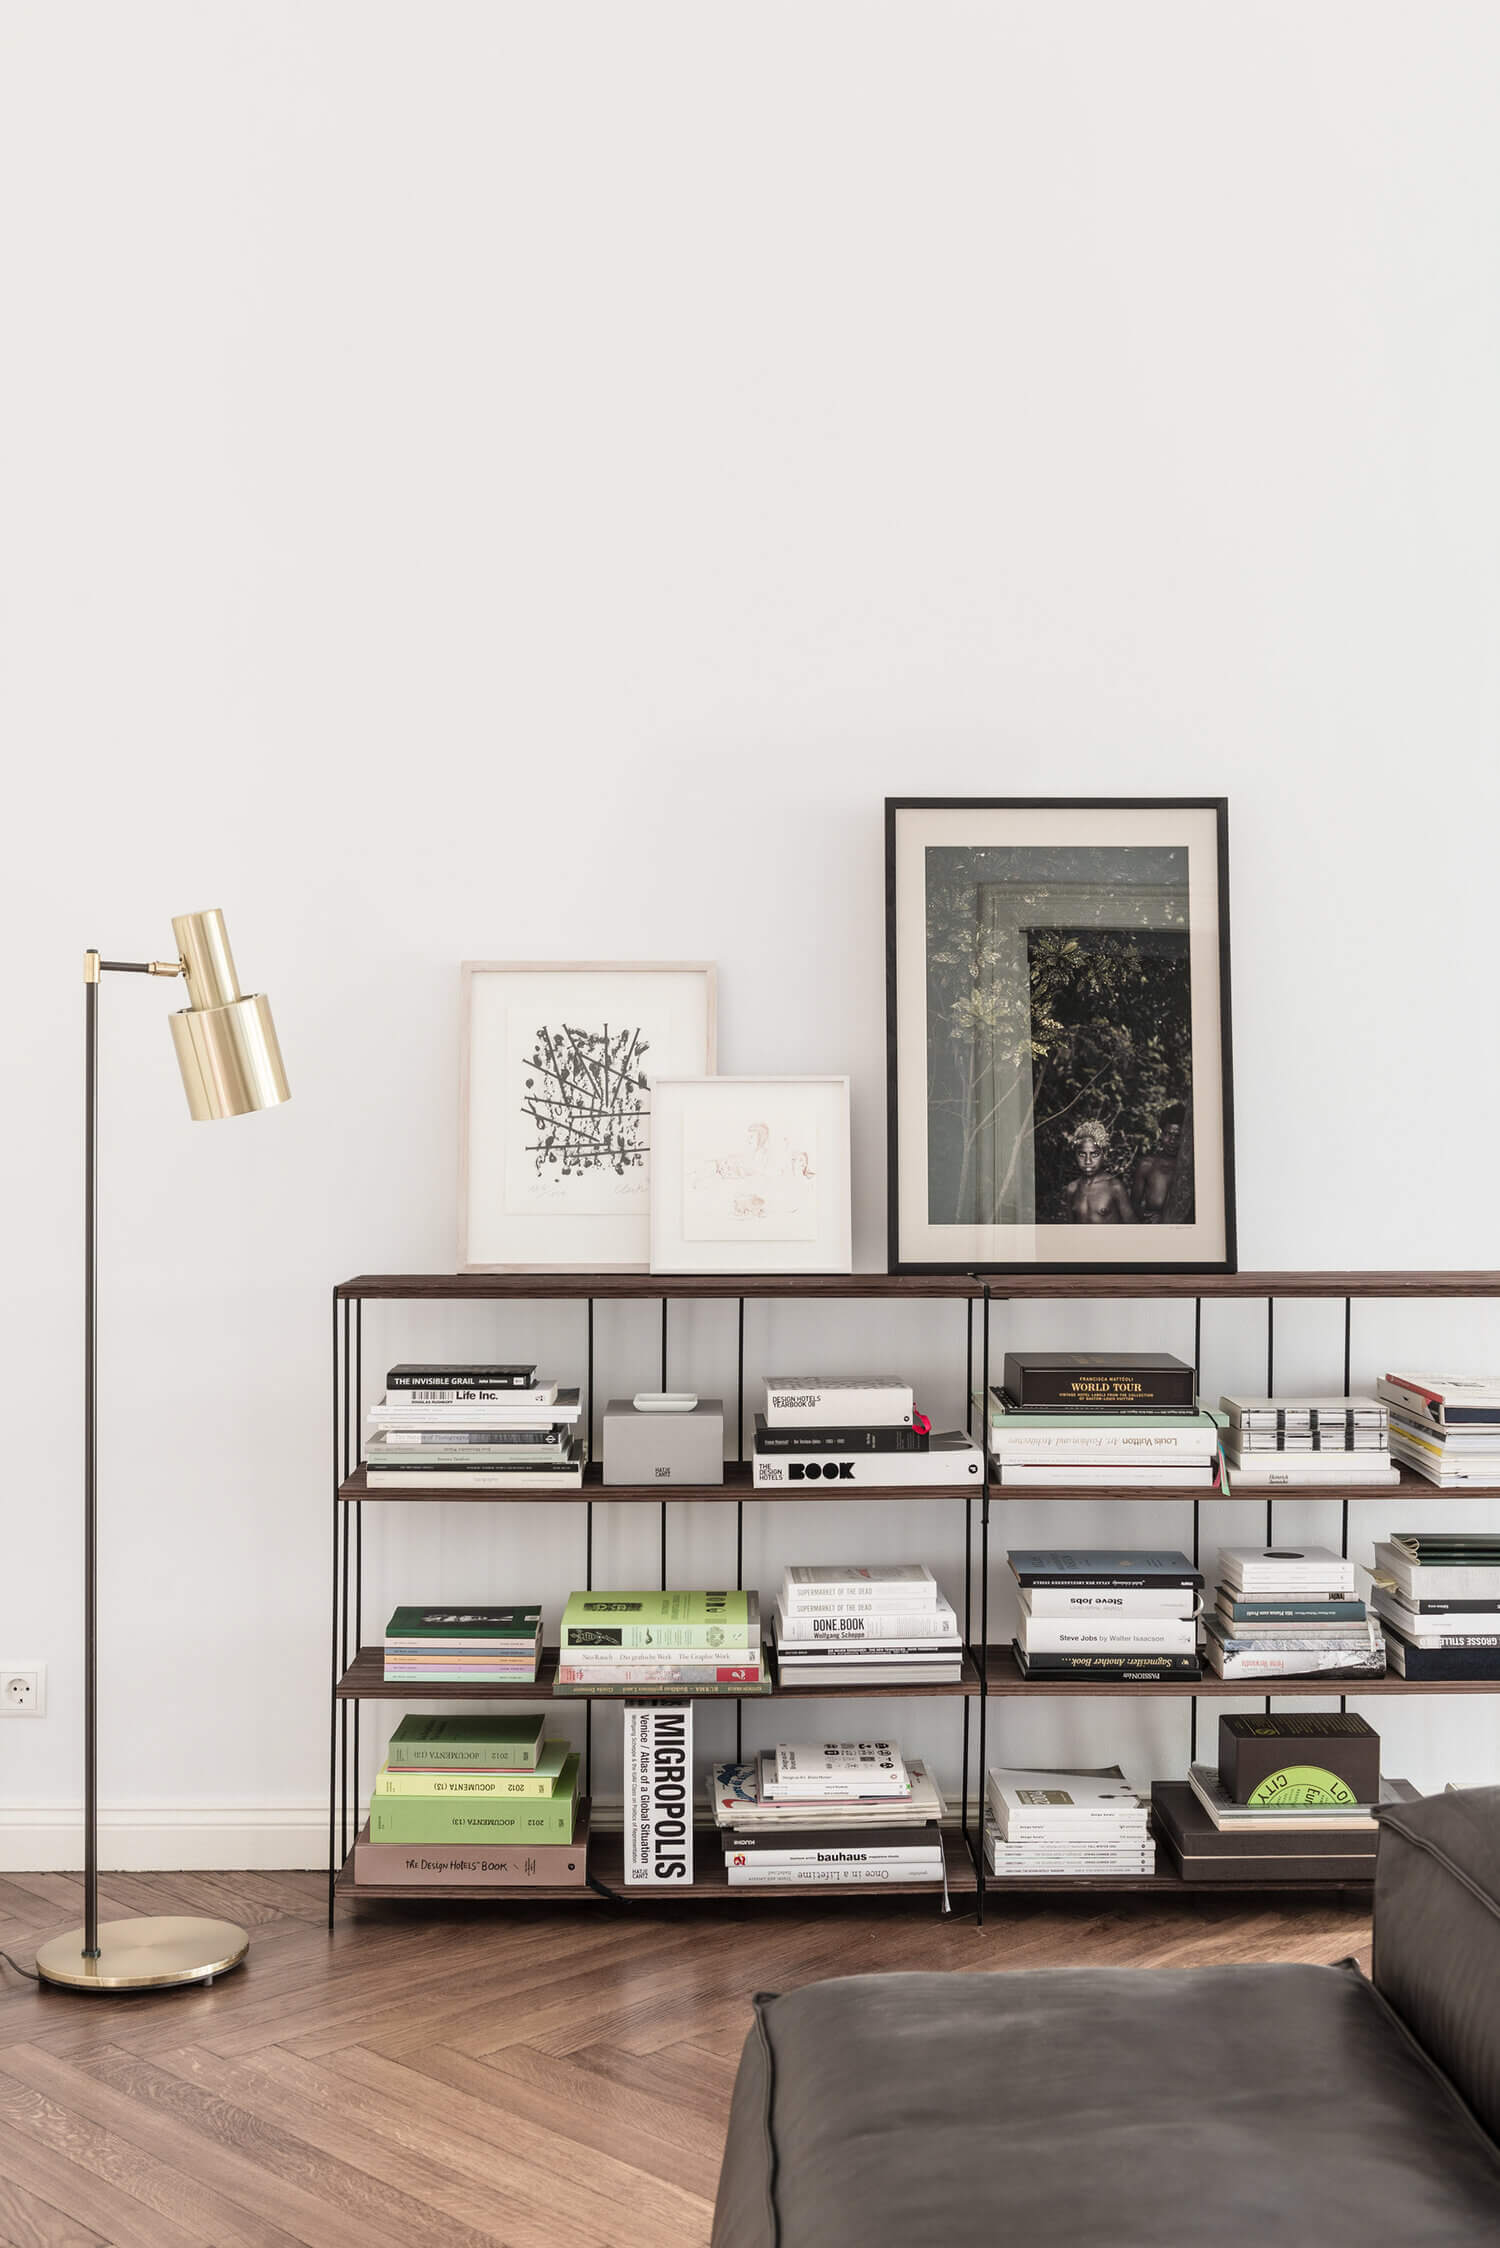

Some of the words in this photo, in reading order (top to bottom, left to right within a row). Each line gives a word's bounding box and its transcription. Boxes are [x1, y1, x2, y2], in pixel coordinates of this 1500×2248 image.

[1071, 1383, 1110, 1392] WORLD
[1113, 1383, 1142, 1392] TOUR
[456, 1391, 476, 1400] Life
[479, 1391, 498, 1400] Inc.
[1122, 1438, 1154, 1446] Vuitton
[1154, 1438, 1177, 1446] Louis
[788, 1462, 856, 1480] BOOK
[797, 1588, 836, 1596] SUPERMARKET
[837, 1588, 845, 1596] OF
[846, 1588, 856, 1596] THE
[858, 1588, 872, 1596] DEAD
[797, 1604, 836, 1613] SUPERMARKET
[837, 1604, 845, 1612] OF
[846, 1604, 856, 1612] THE
[858, 1604, 872, 1612] DEAD
[813, 1618, 865, 1632] DONE.BOOK
[1466, 1637, 1497, 1646] GROSSE
[1094, 1658, 1125, 1667] Another
[640, 1714, 650, 1743] Venice
[429, 1751, 480, 1760] dOCUMENTA
[640, 1751, 650, 1773] Atlas
[640, 1775, 649, 1785] of
[433, 1782, 448, 1791] (13)
[449, 1783, 496, 1792] dOCUMENTA
[1258, 1774, 1288, 1804] CITY
[654, 1714, 686, 1879] MIGROPOLIS
[640, 1795, 650, 1820] Global
[467, 1818, 515, 1826] dOCUMENTA
[640, 1823, 650, 1864] Situation
[817, 1852, 867, 1862] bauhaus
[797, 1871, 840, 1881] Lifetime
[865, 1870, 889, 1879] Once
